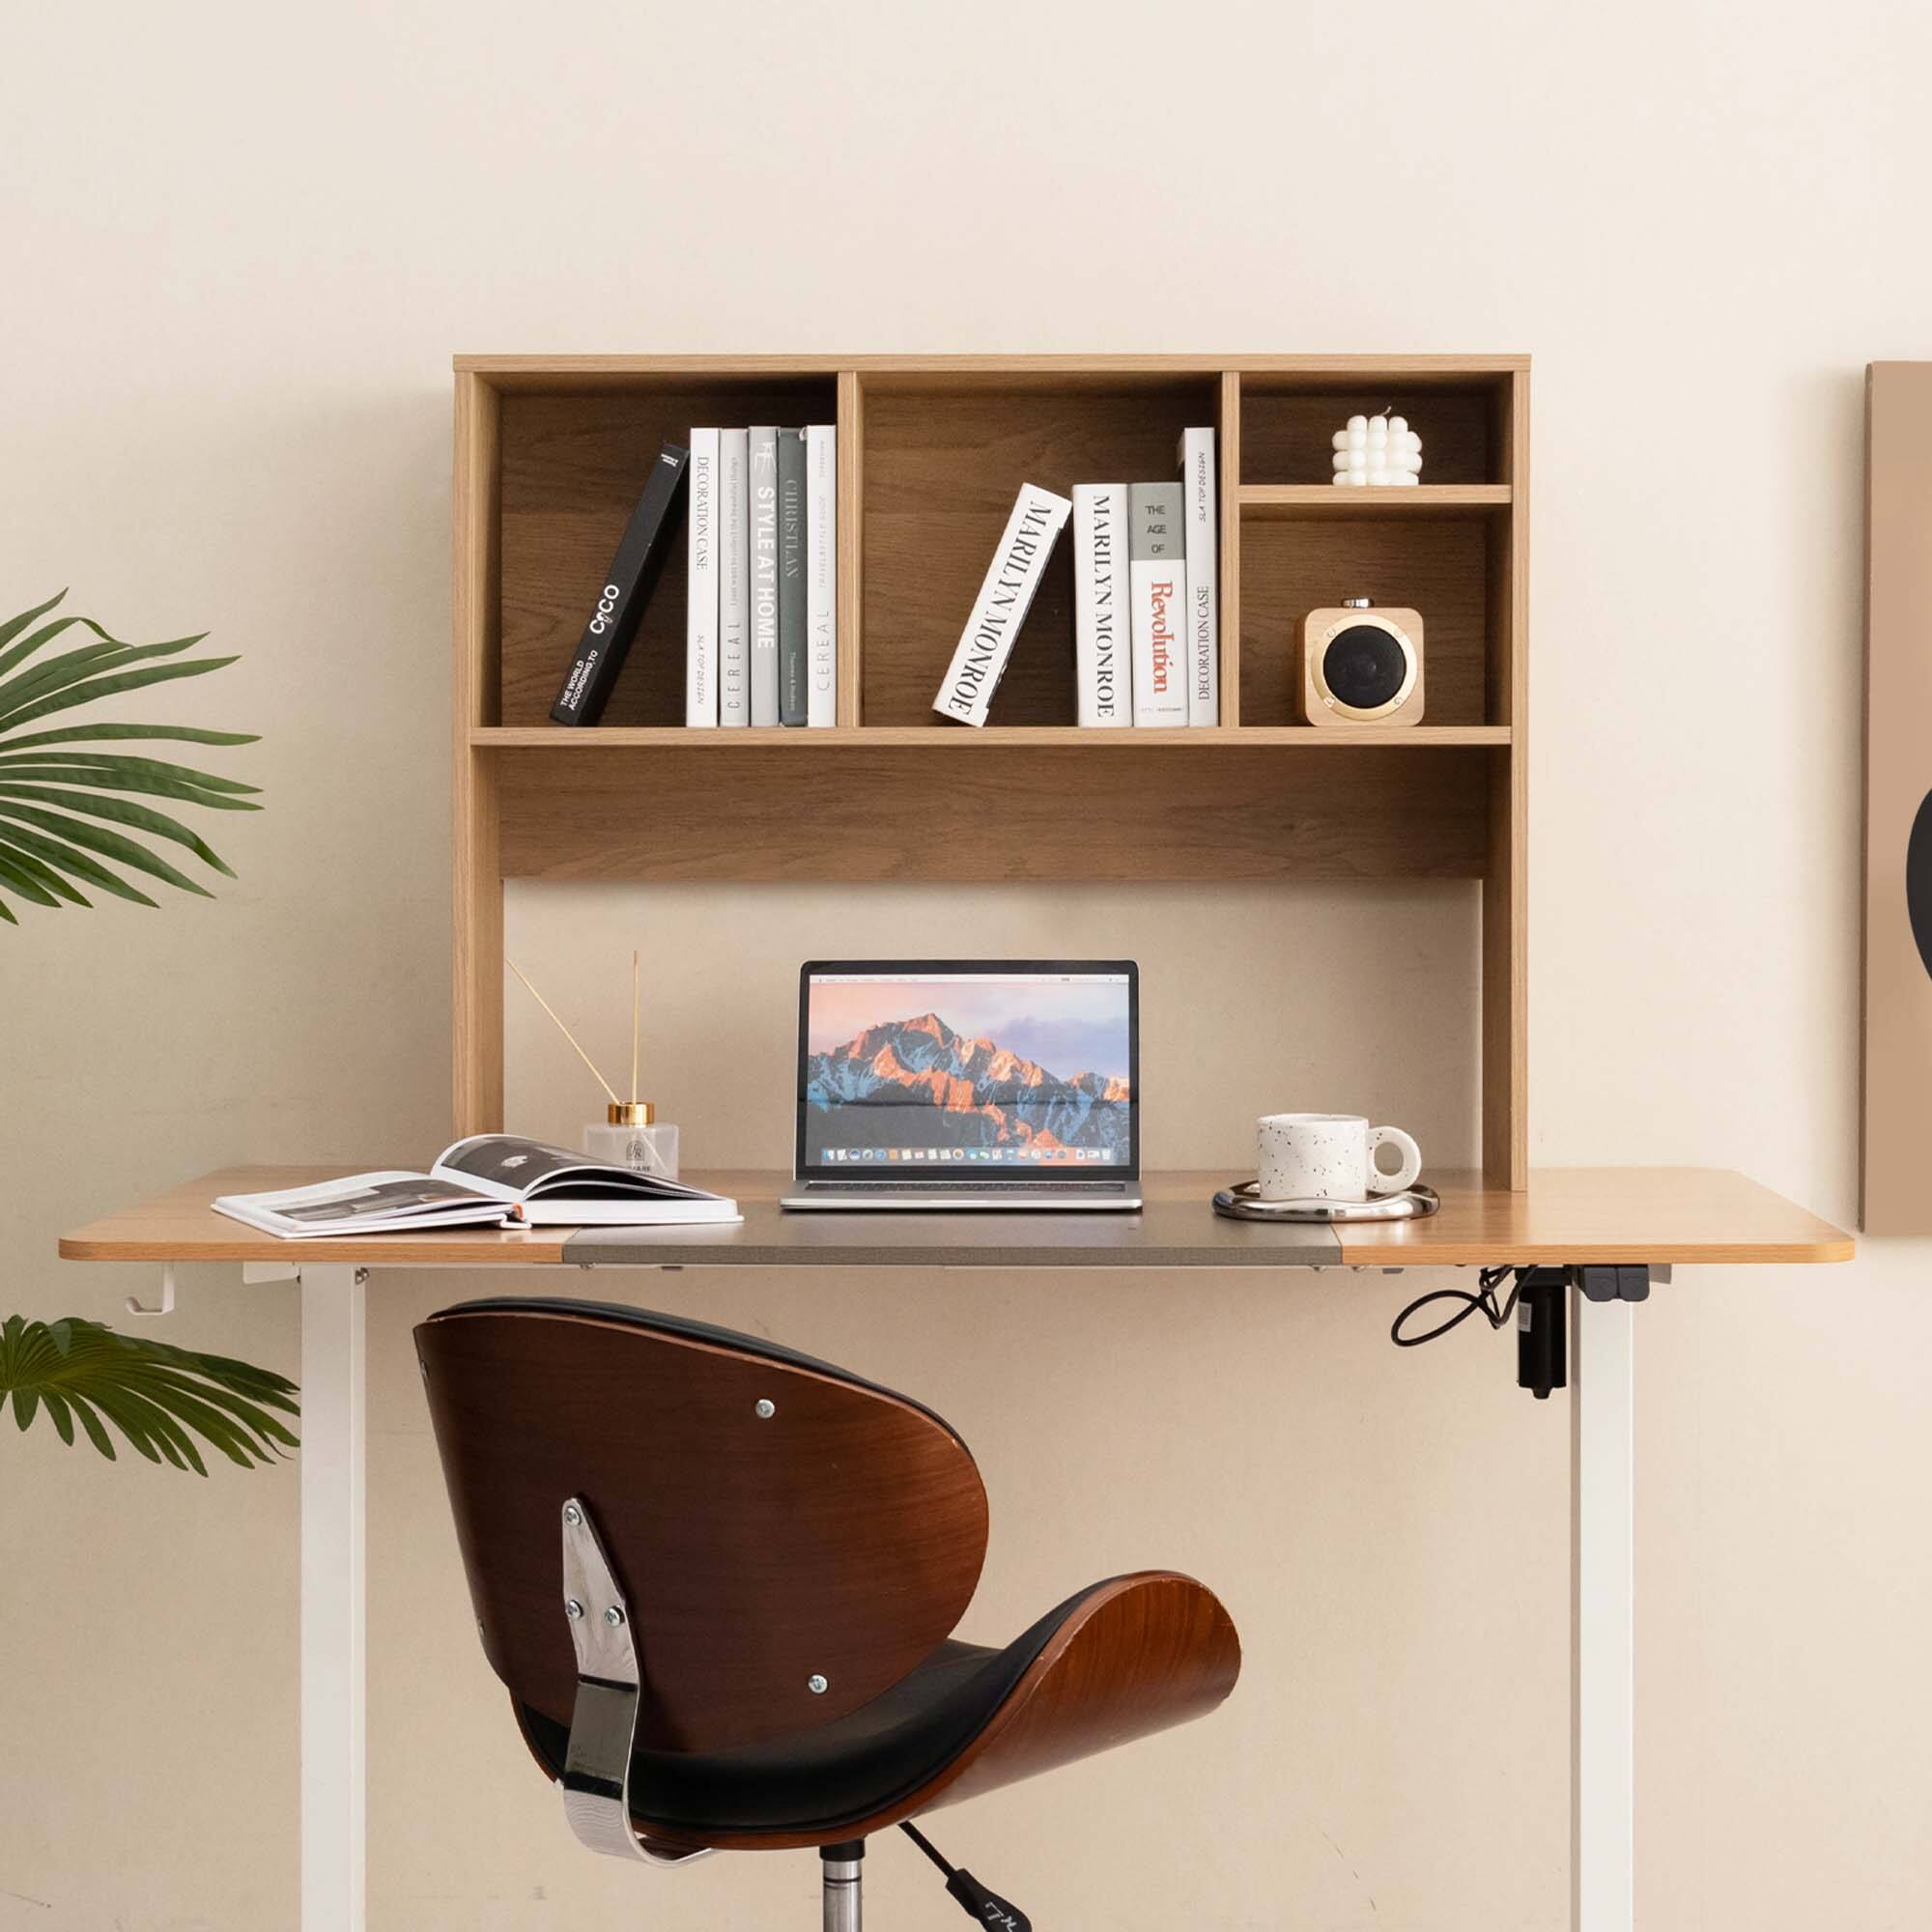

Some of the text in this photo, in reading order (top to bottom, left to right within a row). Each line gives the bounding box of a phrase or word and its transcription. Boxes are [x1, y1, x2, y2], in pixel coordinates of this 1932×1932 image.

[696, 457, 709, 571] DECORATION CASE
[1145, 505, 1166, 515] THE
[1147, 525, 1167, 534] AGE
[1151, 544, 1165, 554] OF
[757, 487, 775, 648] STYLE AT HOME
[949, 500, 1052, 716] MARILYN MONROE
[1094, 496, 1114, 718] MARILYN MONROE
[569, 649, 599, 711] ACCORDING TO
[727, 622, 740, 709] CEREAL
[816, 611, 830, 692] CEREAL
[1151, 581, 1175, 695] Revolution
[1198, 585, 1209, 700] DECORATION CASE
[560, 660, 584, 707] THE WORLD
